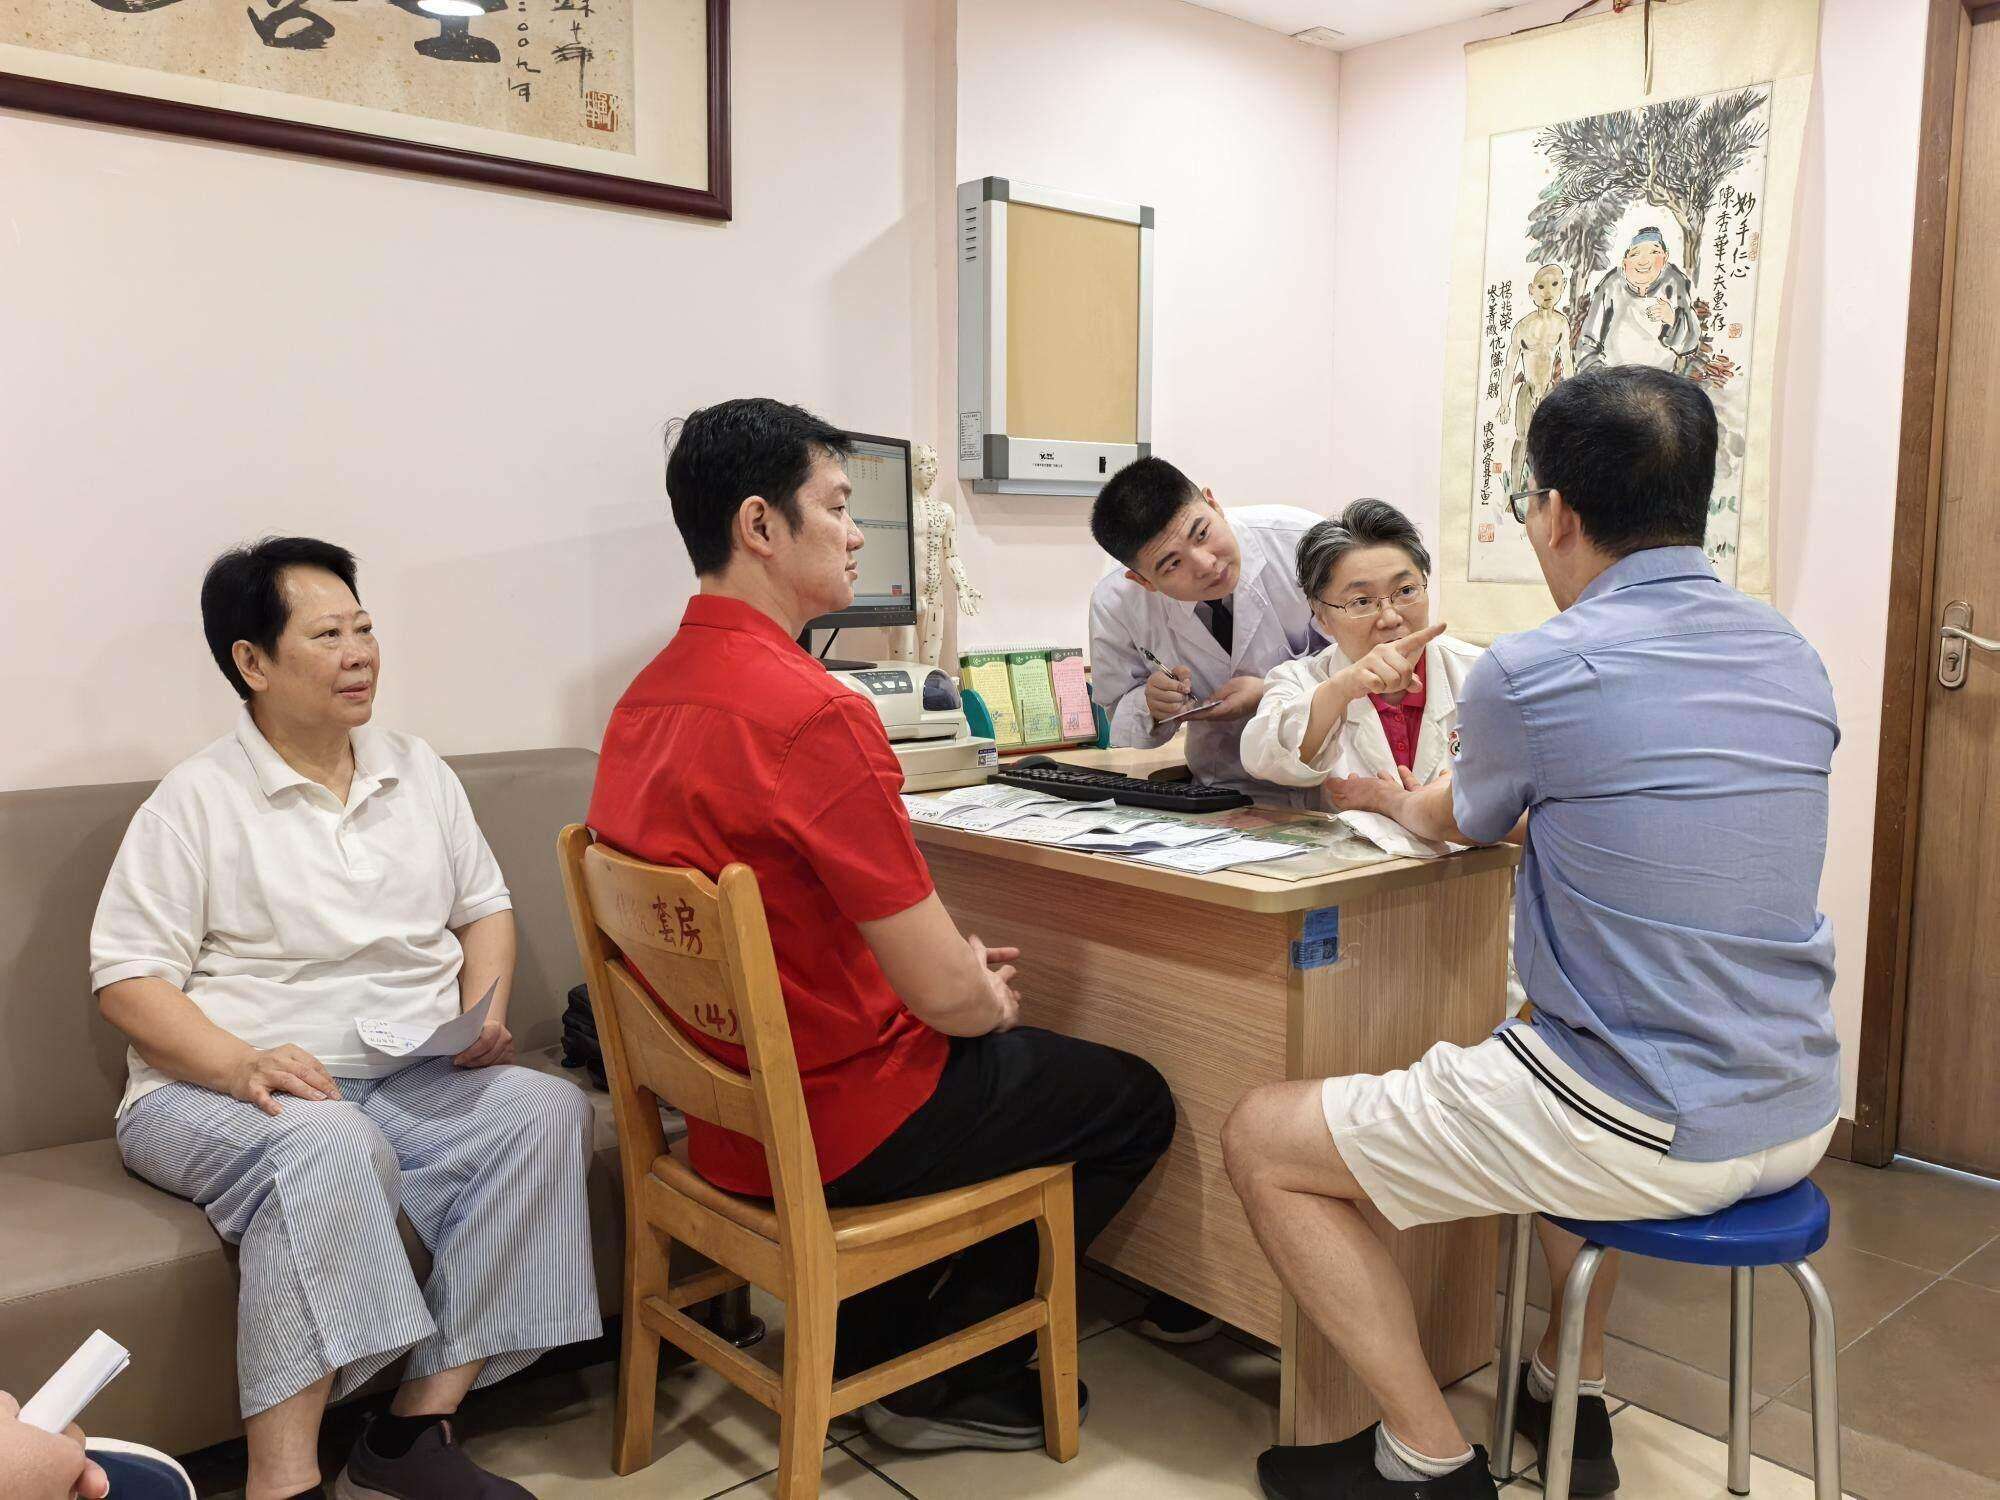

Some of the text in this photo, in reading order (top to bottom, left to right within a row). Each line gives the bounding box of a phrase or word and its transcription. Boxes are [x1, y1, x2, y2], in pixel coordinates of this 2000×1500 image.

[1731, 192, 1756, 278] 妙手仁心
[694, 1003, 738, 1038] (4)
